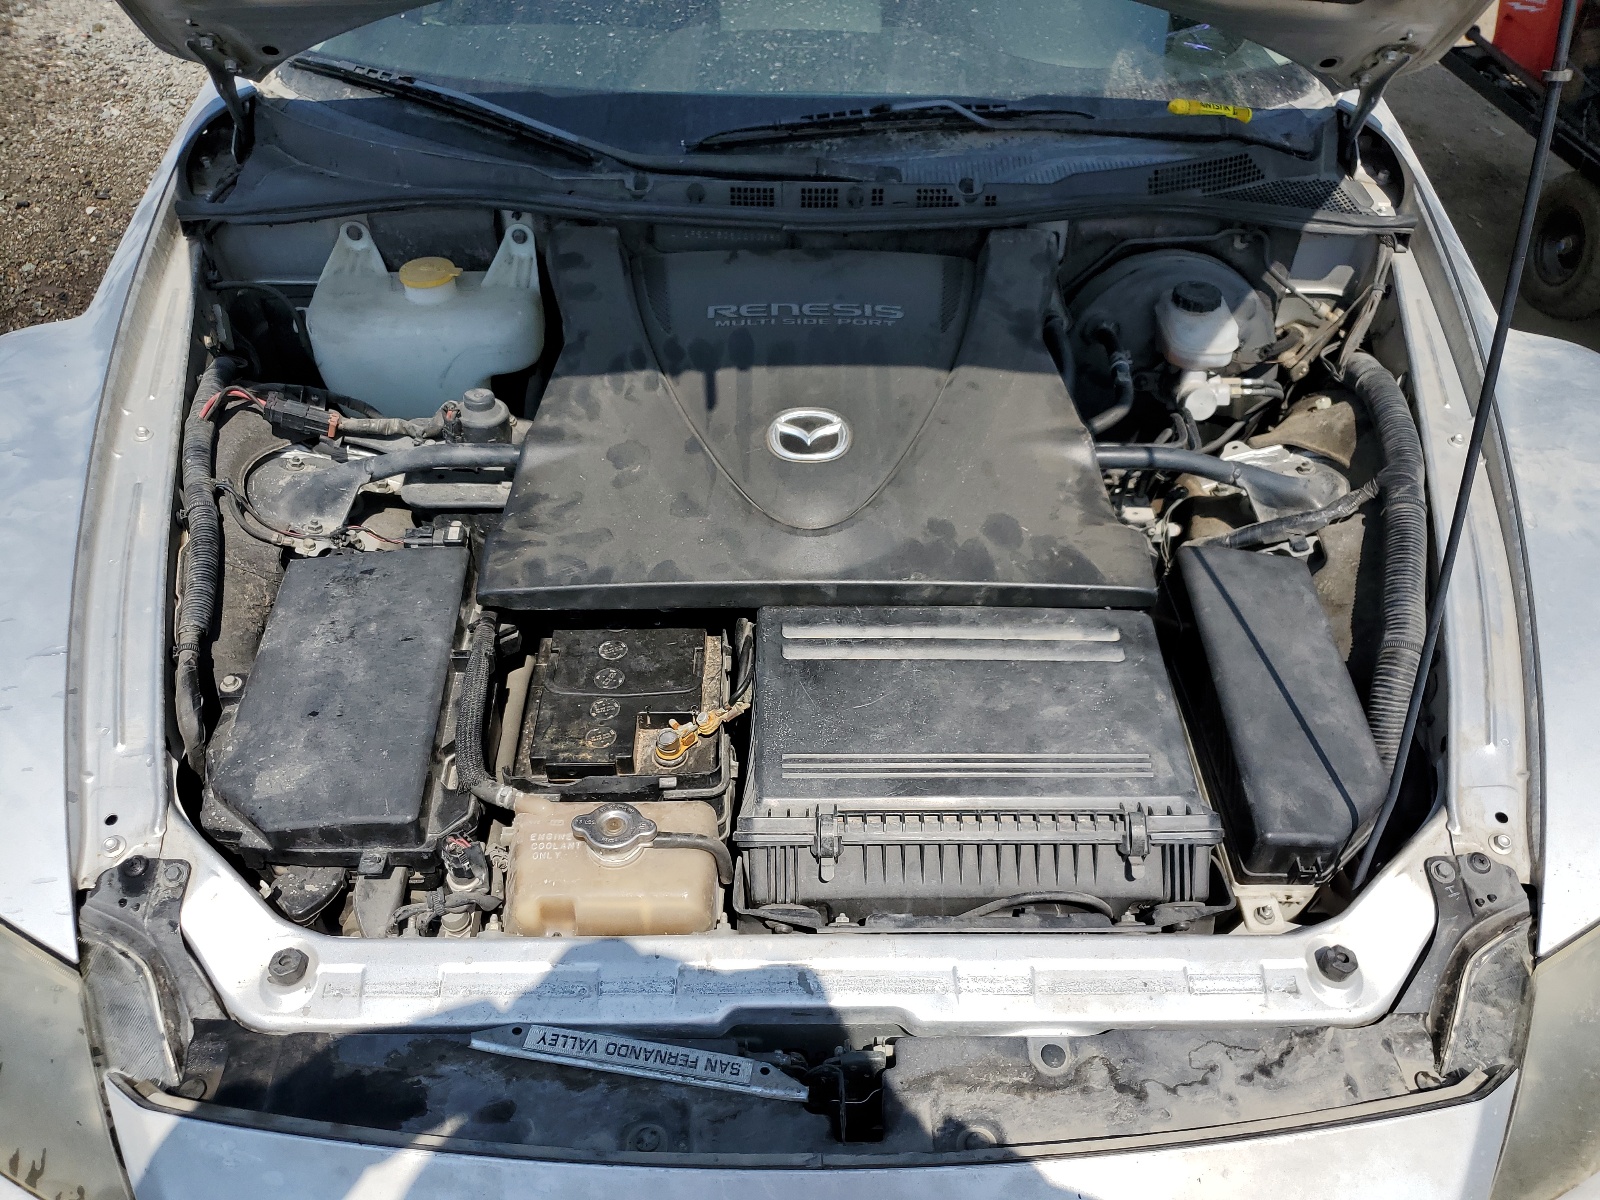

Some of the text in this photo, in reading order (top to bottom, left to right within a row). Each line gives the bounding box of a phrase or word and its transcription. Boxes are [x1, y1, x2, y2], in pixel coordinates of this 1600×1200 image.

[706, 303, 905, 319] RENESIS
[715, 318, 776, 327] MULTI
[837, 318, 897, 327] PORT
[530, 833, 573, 841] ENGINE
[531, 842, 582, 850] COOLANT
[532, 851, 562, 860] ONLY
[536, 1031, 742, 1077] SAN FERNANDO VALLEY
